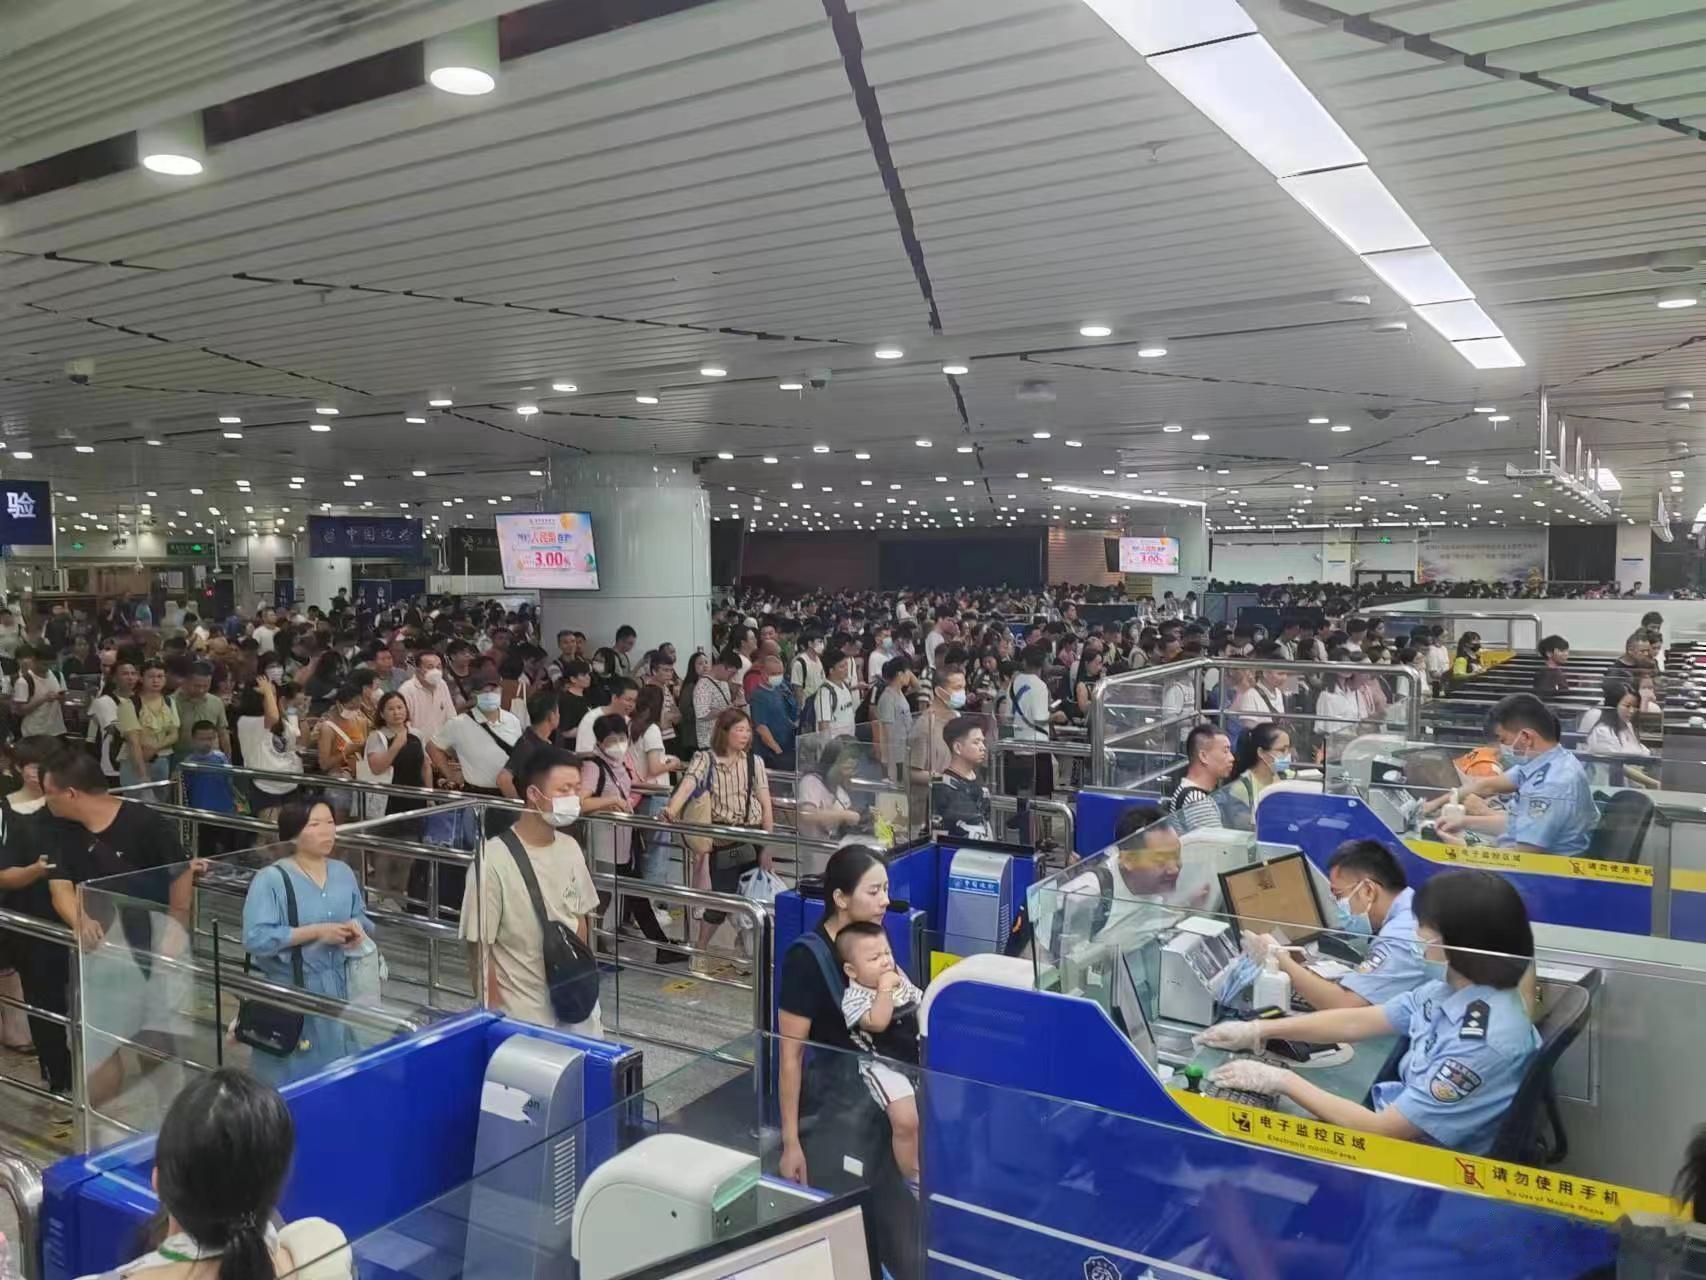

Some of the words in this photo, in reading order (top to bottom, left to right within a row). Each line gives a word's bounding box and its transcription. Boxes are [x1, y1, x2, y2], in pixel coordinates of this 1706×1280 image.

[6, 491, 37, 519] 验
[1260, 1115, 1366, 1151] 电子监控区域
[1492, 1165, 1620, 1206] 请勿使用手机
